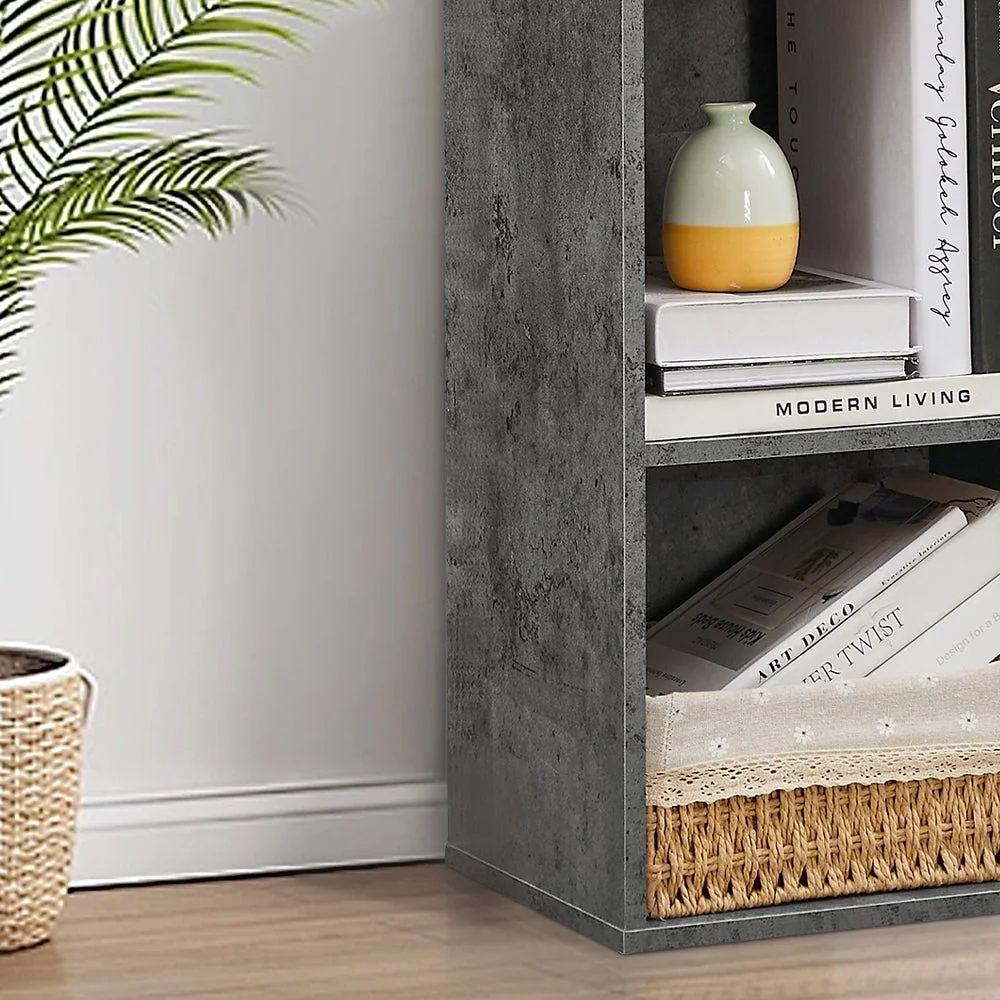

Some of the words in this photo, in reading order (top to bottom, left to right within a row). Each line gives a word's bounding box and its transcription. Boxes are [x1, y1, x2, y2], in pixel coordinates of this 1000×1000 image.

[776, 395, 878, 417] MODERN
[892, 389, 972, 408] LIVING
[757, 647, 793, 683] ART
[801, 603, 854, 647] DECO
[836, 607, 905, 667] TWIST
[935, 636, 970, 666] Design
[969, 624, 984, 640] for
